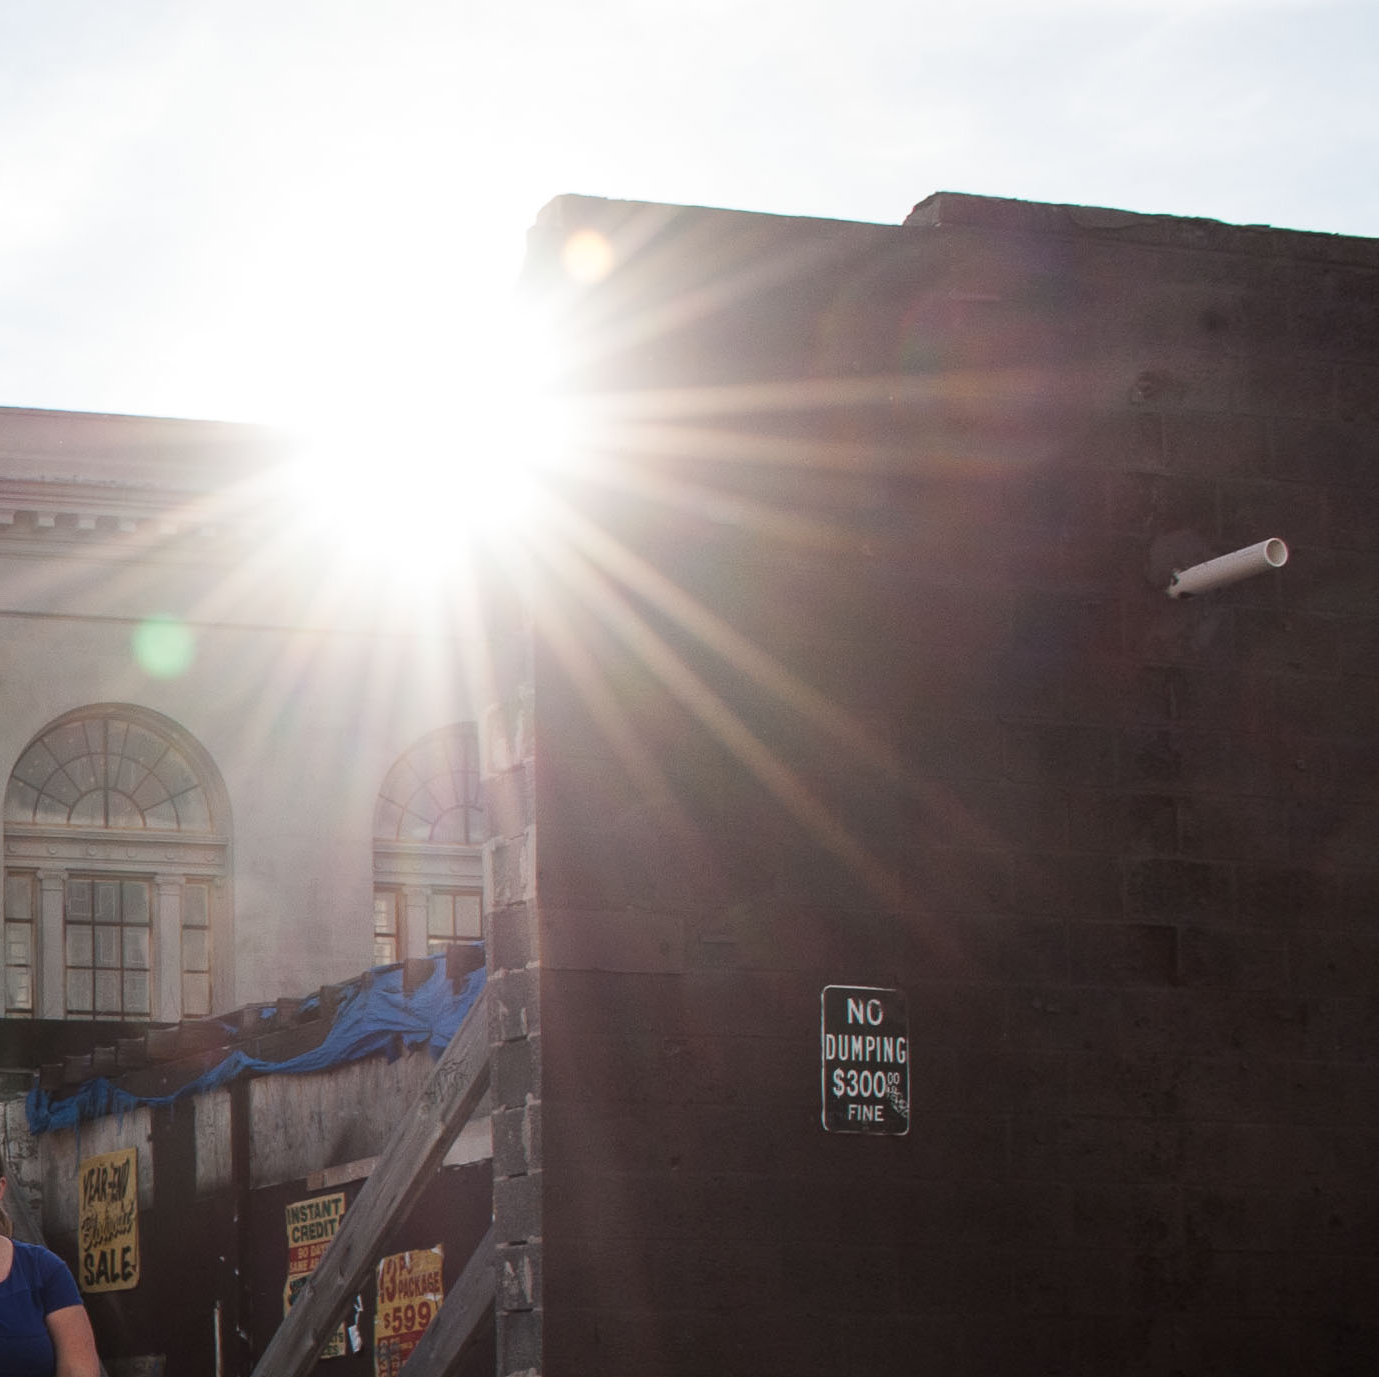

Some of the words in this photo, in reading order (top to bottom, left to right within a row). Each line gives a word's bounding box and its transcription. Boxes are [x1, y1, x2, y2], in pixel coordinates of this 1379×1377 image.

[847, 998, 883, 1026] NO
[825, 1034, 907, 1064] DUMPING
[848, 1104, 885, 1122] FINE
[287, 1197, 342, 1226] INSTANT
[292, 1217, 338, 1243] CREDIT
[83, 1245, 133, 1287] SALE
[398, 1270, 441, 1300] PACKAGE
[383, 1300, 432, 1334] $599
